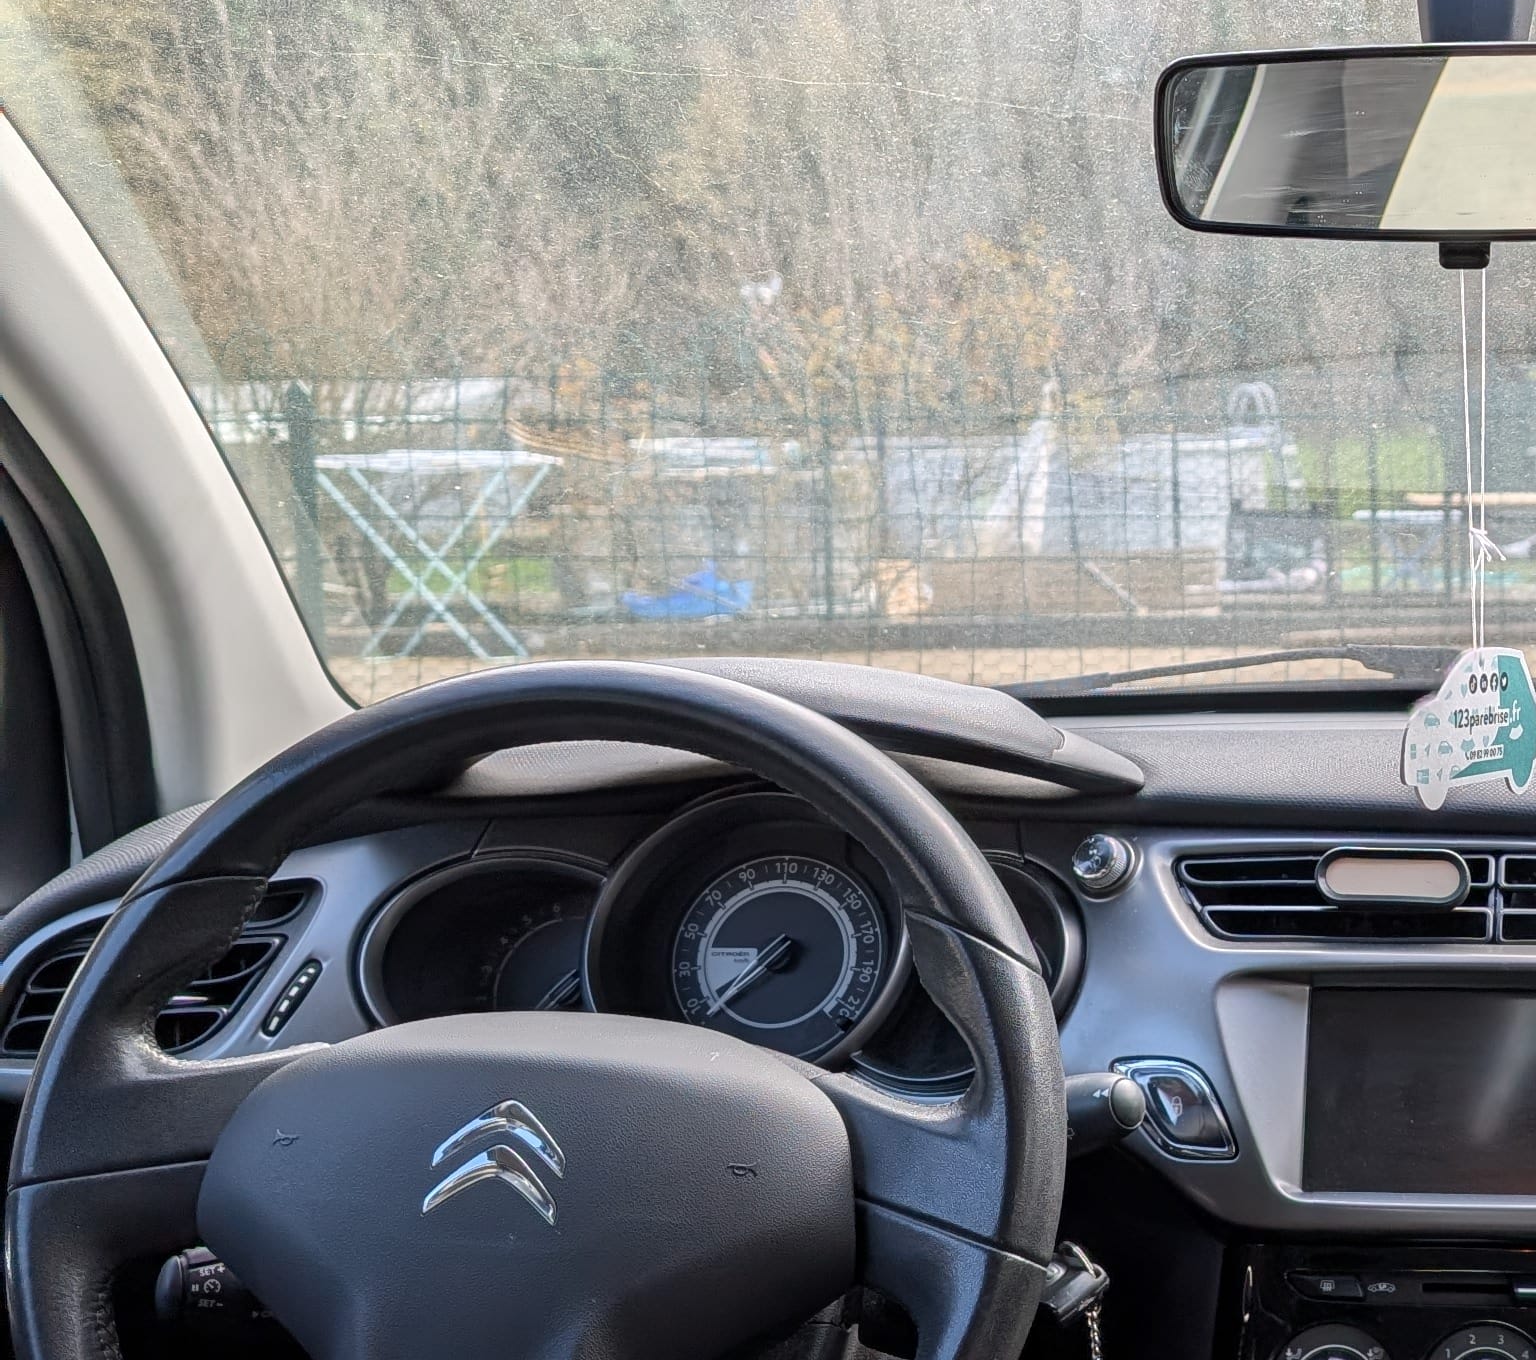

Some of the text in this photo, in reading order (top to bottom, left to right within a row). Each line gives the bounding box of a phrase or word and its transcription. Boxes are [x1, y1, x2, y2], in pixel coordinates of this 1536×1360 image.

[1454, 700, 1521, 735] 123parebrise.fr
[738, 868, 756, 882] 90
[775, 862, 798, 874] 110
[812, 867, 835, 885] 130
[705, 889, 722, 907] 70
[841, 887, 862, 911] 150
[684, 922, 699, 940] 50
[859, 920, 875, 945] 170
[679, 961, 691, 978] 30
[858, 959, 875, 984] 190
[686, 997, 702, 1016] 10
[1469, 1333, 1476, 1345] 2
[1497, 1334, 1505, 1345] 3
[1445, 1348, 1451, 1359] 1
[1521, 1350, 1529, 1360] 4
